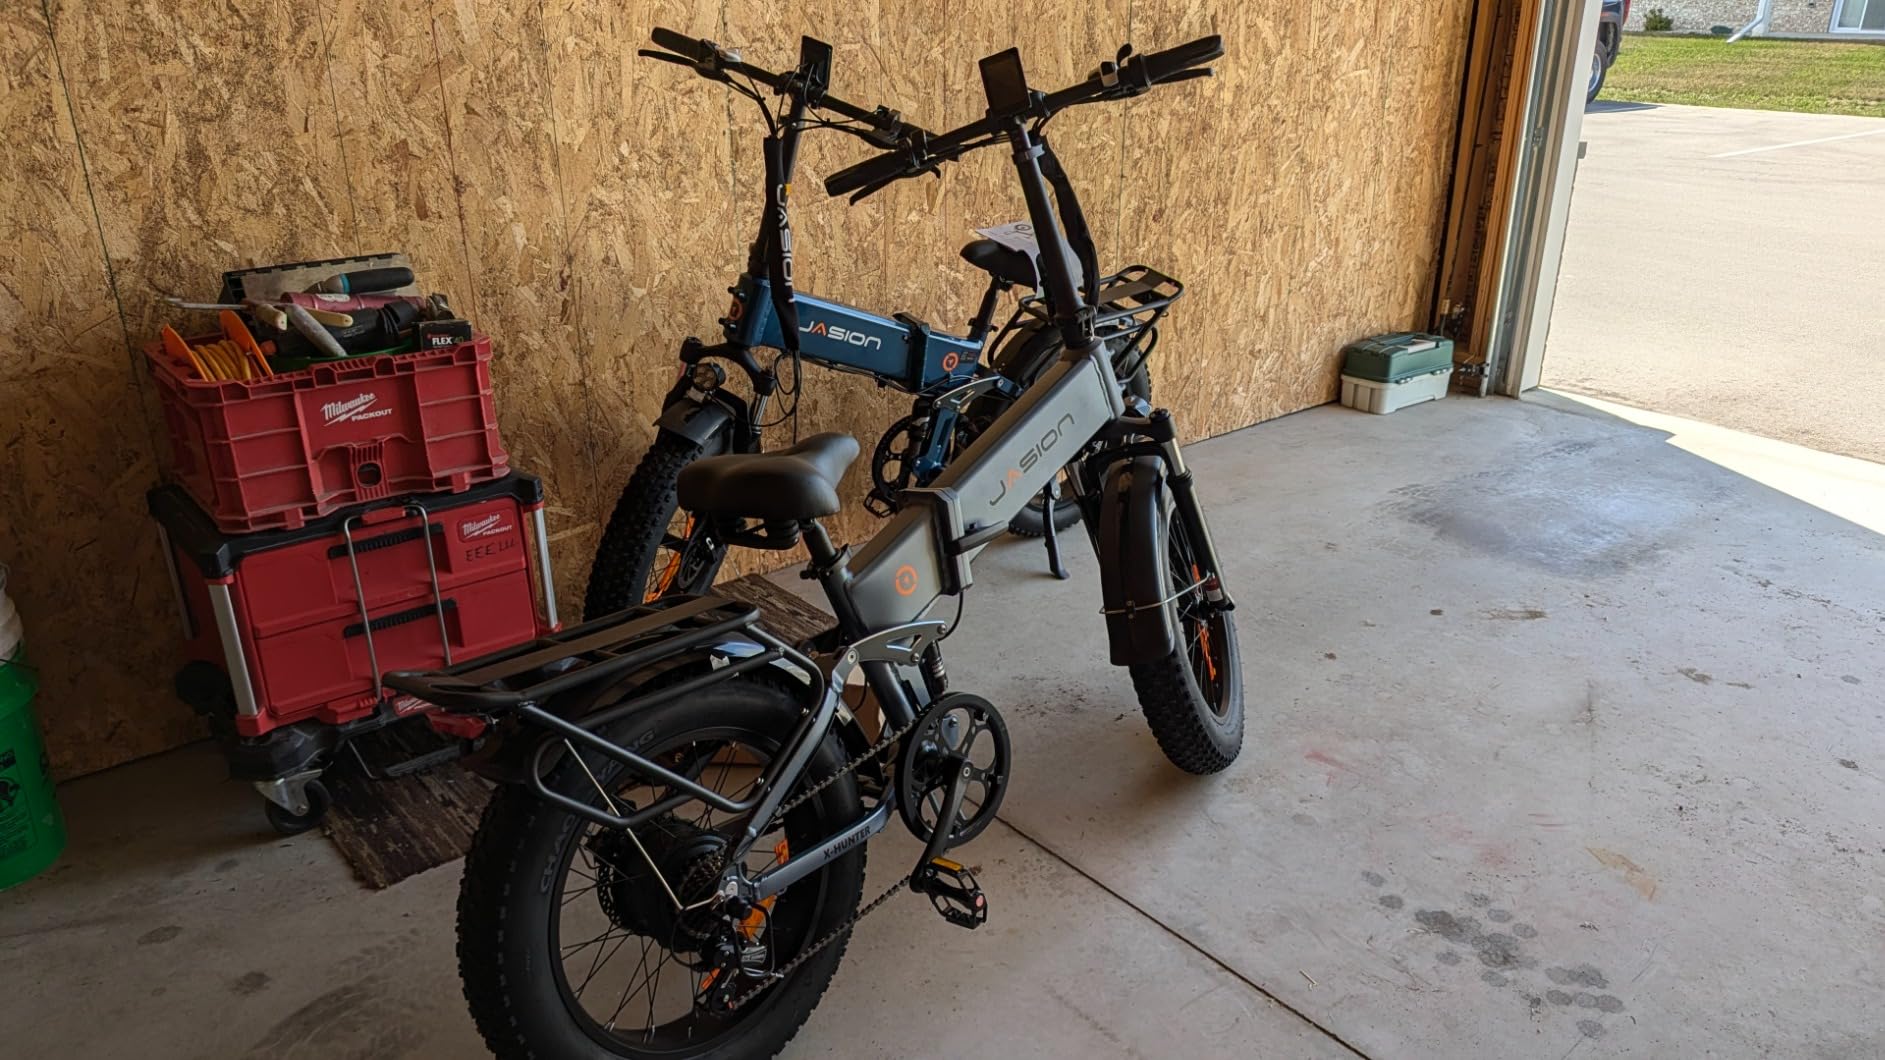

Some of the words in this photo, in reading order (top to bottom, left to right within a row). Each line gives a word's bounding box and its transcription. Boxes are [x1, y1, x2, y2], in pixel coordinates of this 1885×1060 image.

[432, 336, 453, 346] FLEX
[799, 320, 882, 350] JASION
[320, 393, 376, 420] Milwaukee
[351, 408, 392, 421] PACKOUT
[989, 413, 1075, 506] JASION
[462, 514, 500, 536] Milwaukee
[823, 826, 870, 860] X-HUNTER
